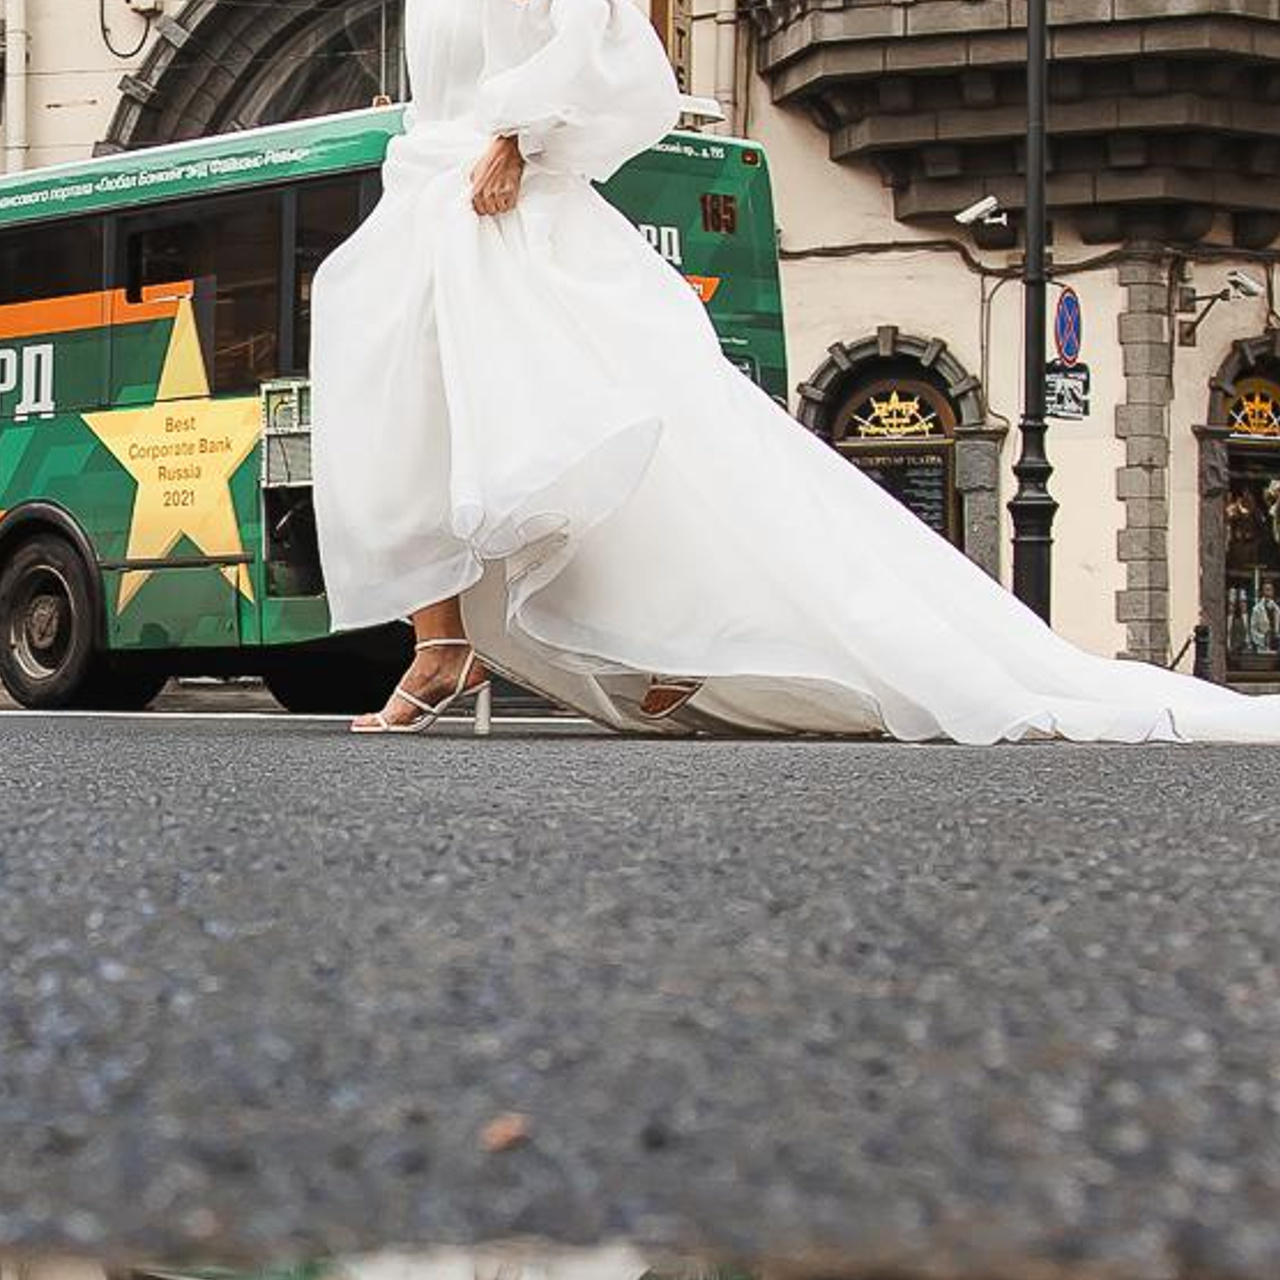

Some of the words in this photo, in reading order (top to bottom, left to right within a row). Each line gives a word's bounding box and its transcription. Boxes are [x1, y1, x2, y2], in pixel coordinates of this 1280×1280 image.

[165, 417, 196, 433] Best
[128, 442, 196, 461] Corporate
[199, 436, 232, 454] Bank
[158, 464, 202, 481] Russia
[163, 489, 195, 507] 2021
